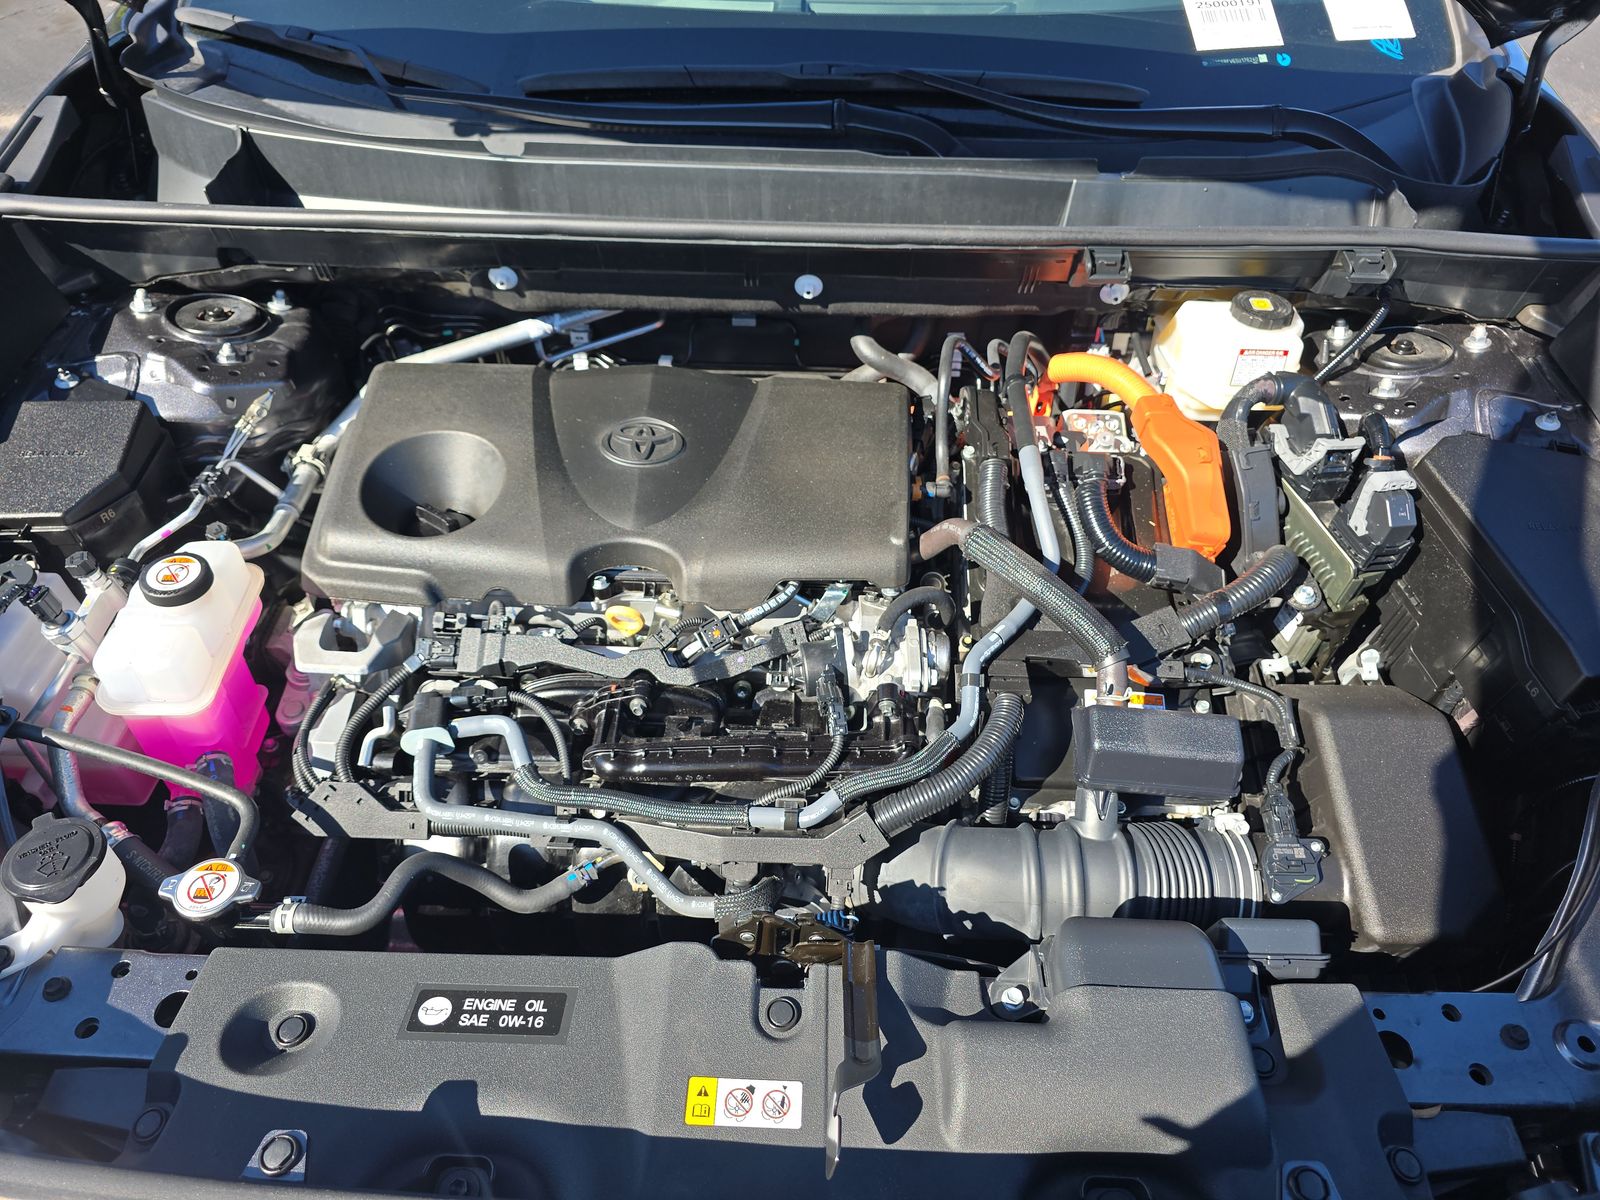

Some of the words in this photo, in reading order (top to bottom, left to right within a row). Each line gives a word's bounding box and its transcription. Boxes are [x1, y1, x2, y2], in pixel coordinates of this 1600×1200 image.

[100, 508, 116, 523] R6
[1525, 680, 1540, 697] L6
[463, 998, 517, 1012] ENGINE
[524, 1000, 548, 1012] OIL
[458, 1014, 490, 1027] SAE
[499, 1016, 544, 1028] 0W-16
